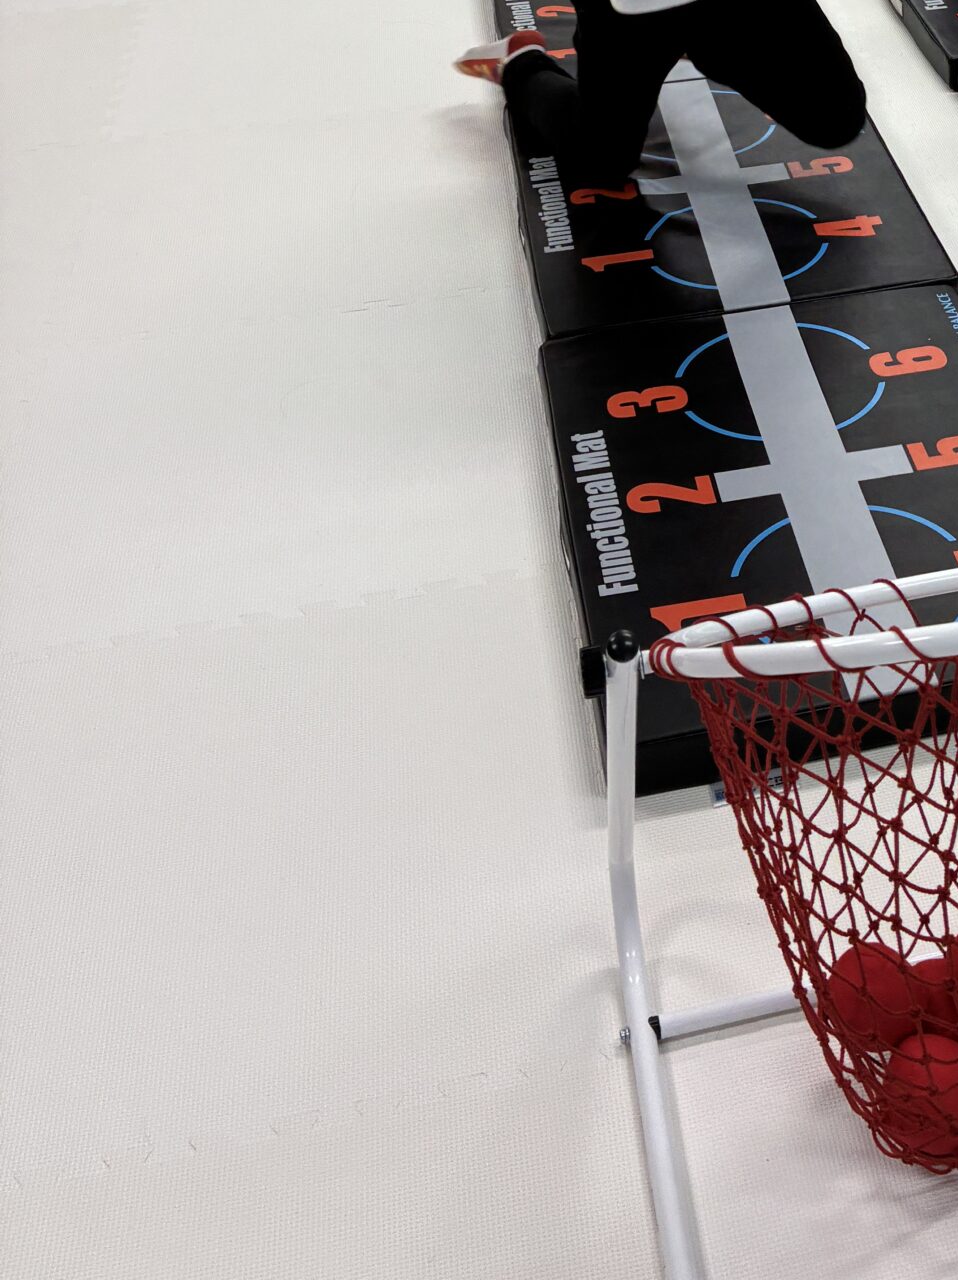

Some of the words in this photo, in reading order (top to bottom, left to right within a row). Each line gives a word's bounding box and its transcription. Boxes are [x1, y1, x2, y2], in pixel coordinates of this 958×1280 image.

[505, 0, 537, 31] ctional
[528, 155, 559, 182] Mat
[787, 156, 854, 179] 5
[570, 183, 638, 205] 2
[532, 180, 575, 254] Functional
[813, 215, 883, 236] 4
[581, 248, 654, 272] 1
[868, 345, 948, 378] 6
[606, 385, 689, 419] 3
[570, 429, 611, 472] Mat
[626, 474, 717, 514] 2
[576, 471, 639, 597] Functional
[649, 593, 747, 633] 1
